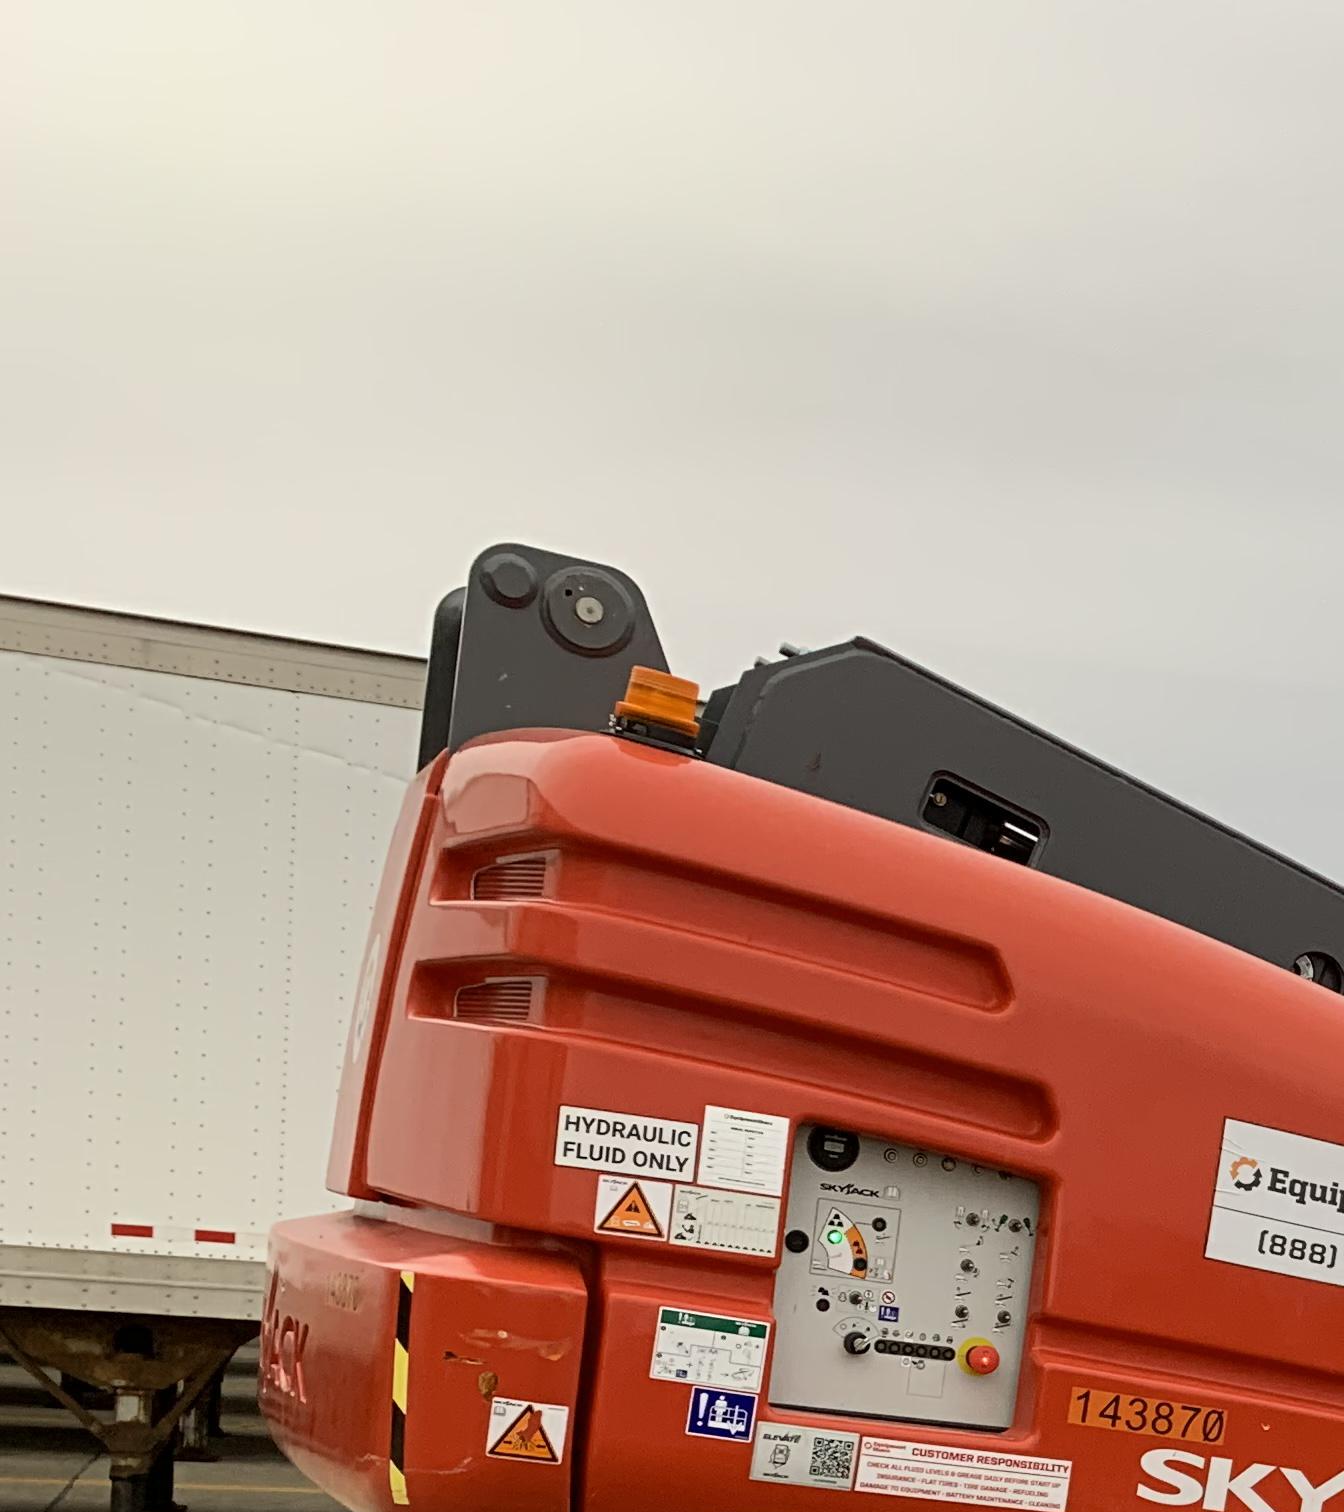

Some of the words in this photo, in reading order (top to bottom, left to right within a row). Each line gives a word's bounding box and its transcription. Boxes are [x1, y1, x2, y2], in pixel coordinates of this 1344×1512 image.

[564, 1114, 693, 1147] HYDRAULIC
[562, 1141, 626, 1165] FLUID
[632, 1151, 690, 1173] ONLY
[819, 1183, 880, 1198] SKYJACK
[1257, 1229, 1338, 1270] (888)
[1074, 1390, 1226, 1444] 143870
[867, 1461, 889, 1470] CHECK
[891, 1463, 903, 1471] ALL
[957, 1472, 983, 1480] GREASE
[983, 1475, 1003, 1483] DAILY
[911, 1447, 975, 1463] CUSTOMER
[976, 1455, 1070, 1474] RESPONSIBILITY
[900, 1485, 941, 1496] EQUIPMENT
[1012, 1488, 1049, 1498] REFUELING
